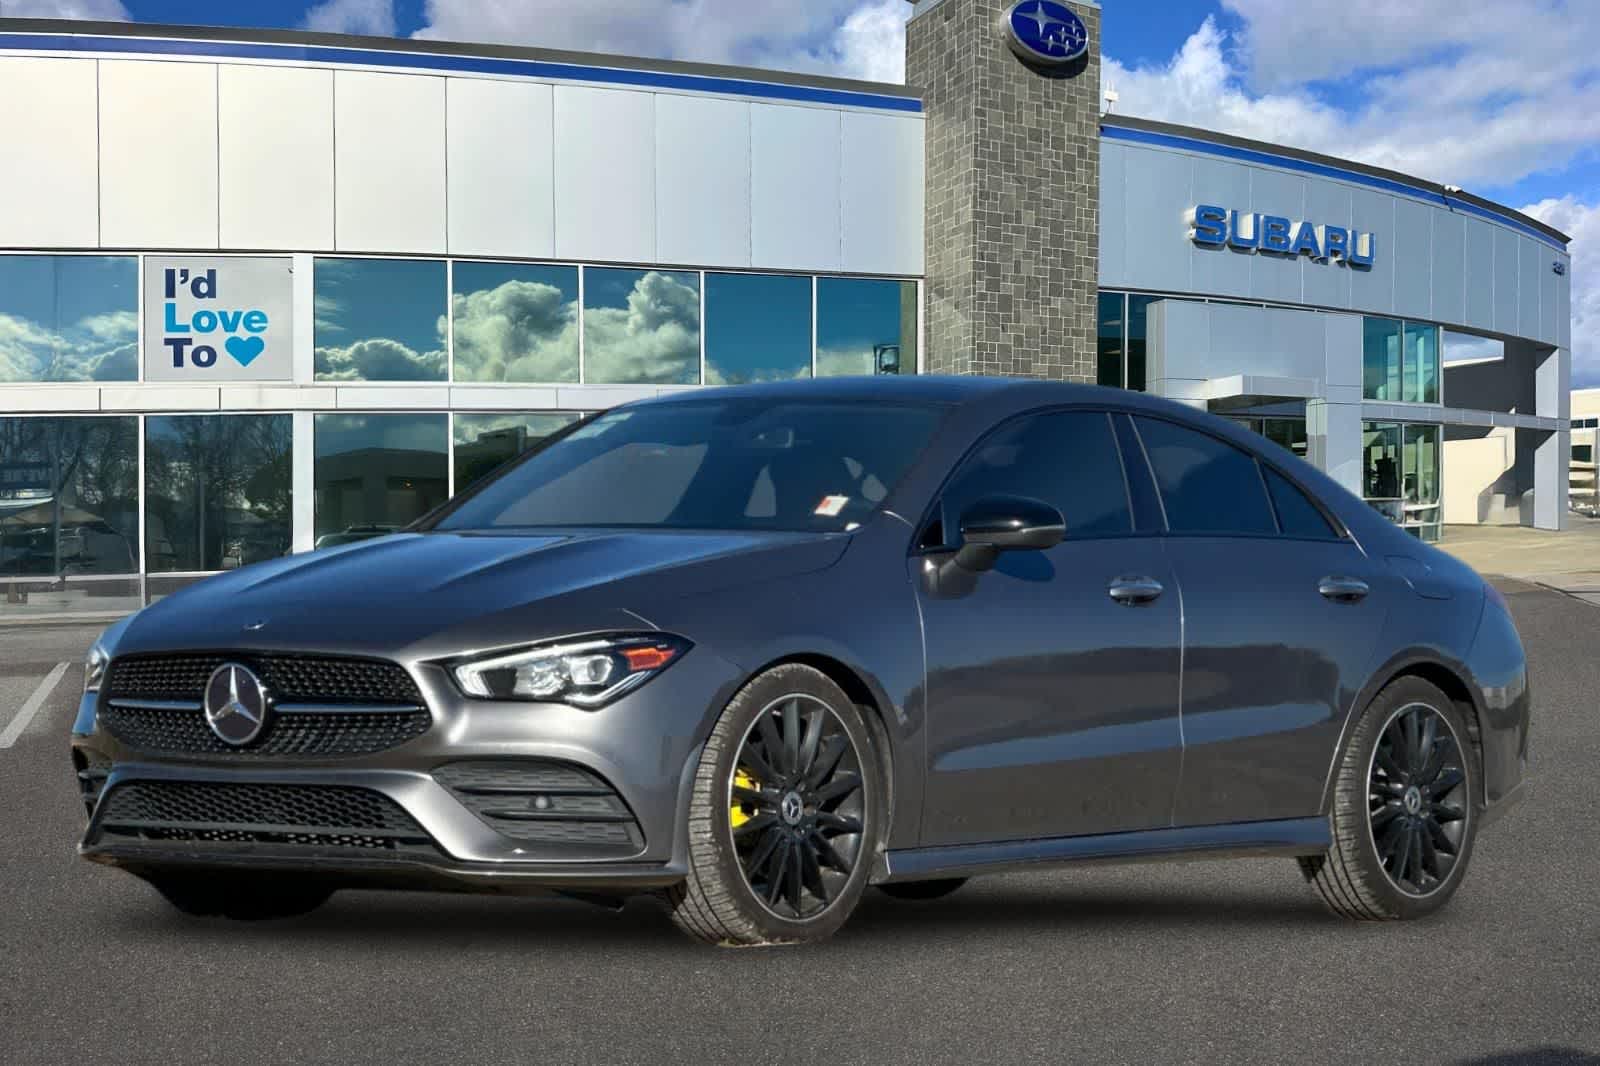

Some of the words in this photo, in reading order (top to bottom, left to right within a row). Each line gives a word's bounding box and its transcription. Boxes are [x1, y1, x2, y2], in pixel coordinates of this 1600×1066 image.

[1191, 204, 1376, 271] SUBARU
[165, 302, 268, 333] Love
[164, 337, 217, 368] To
